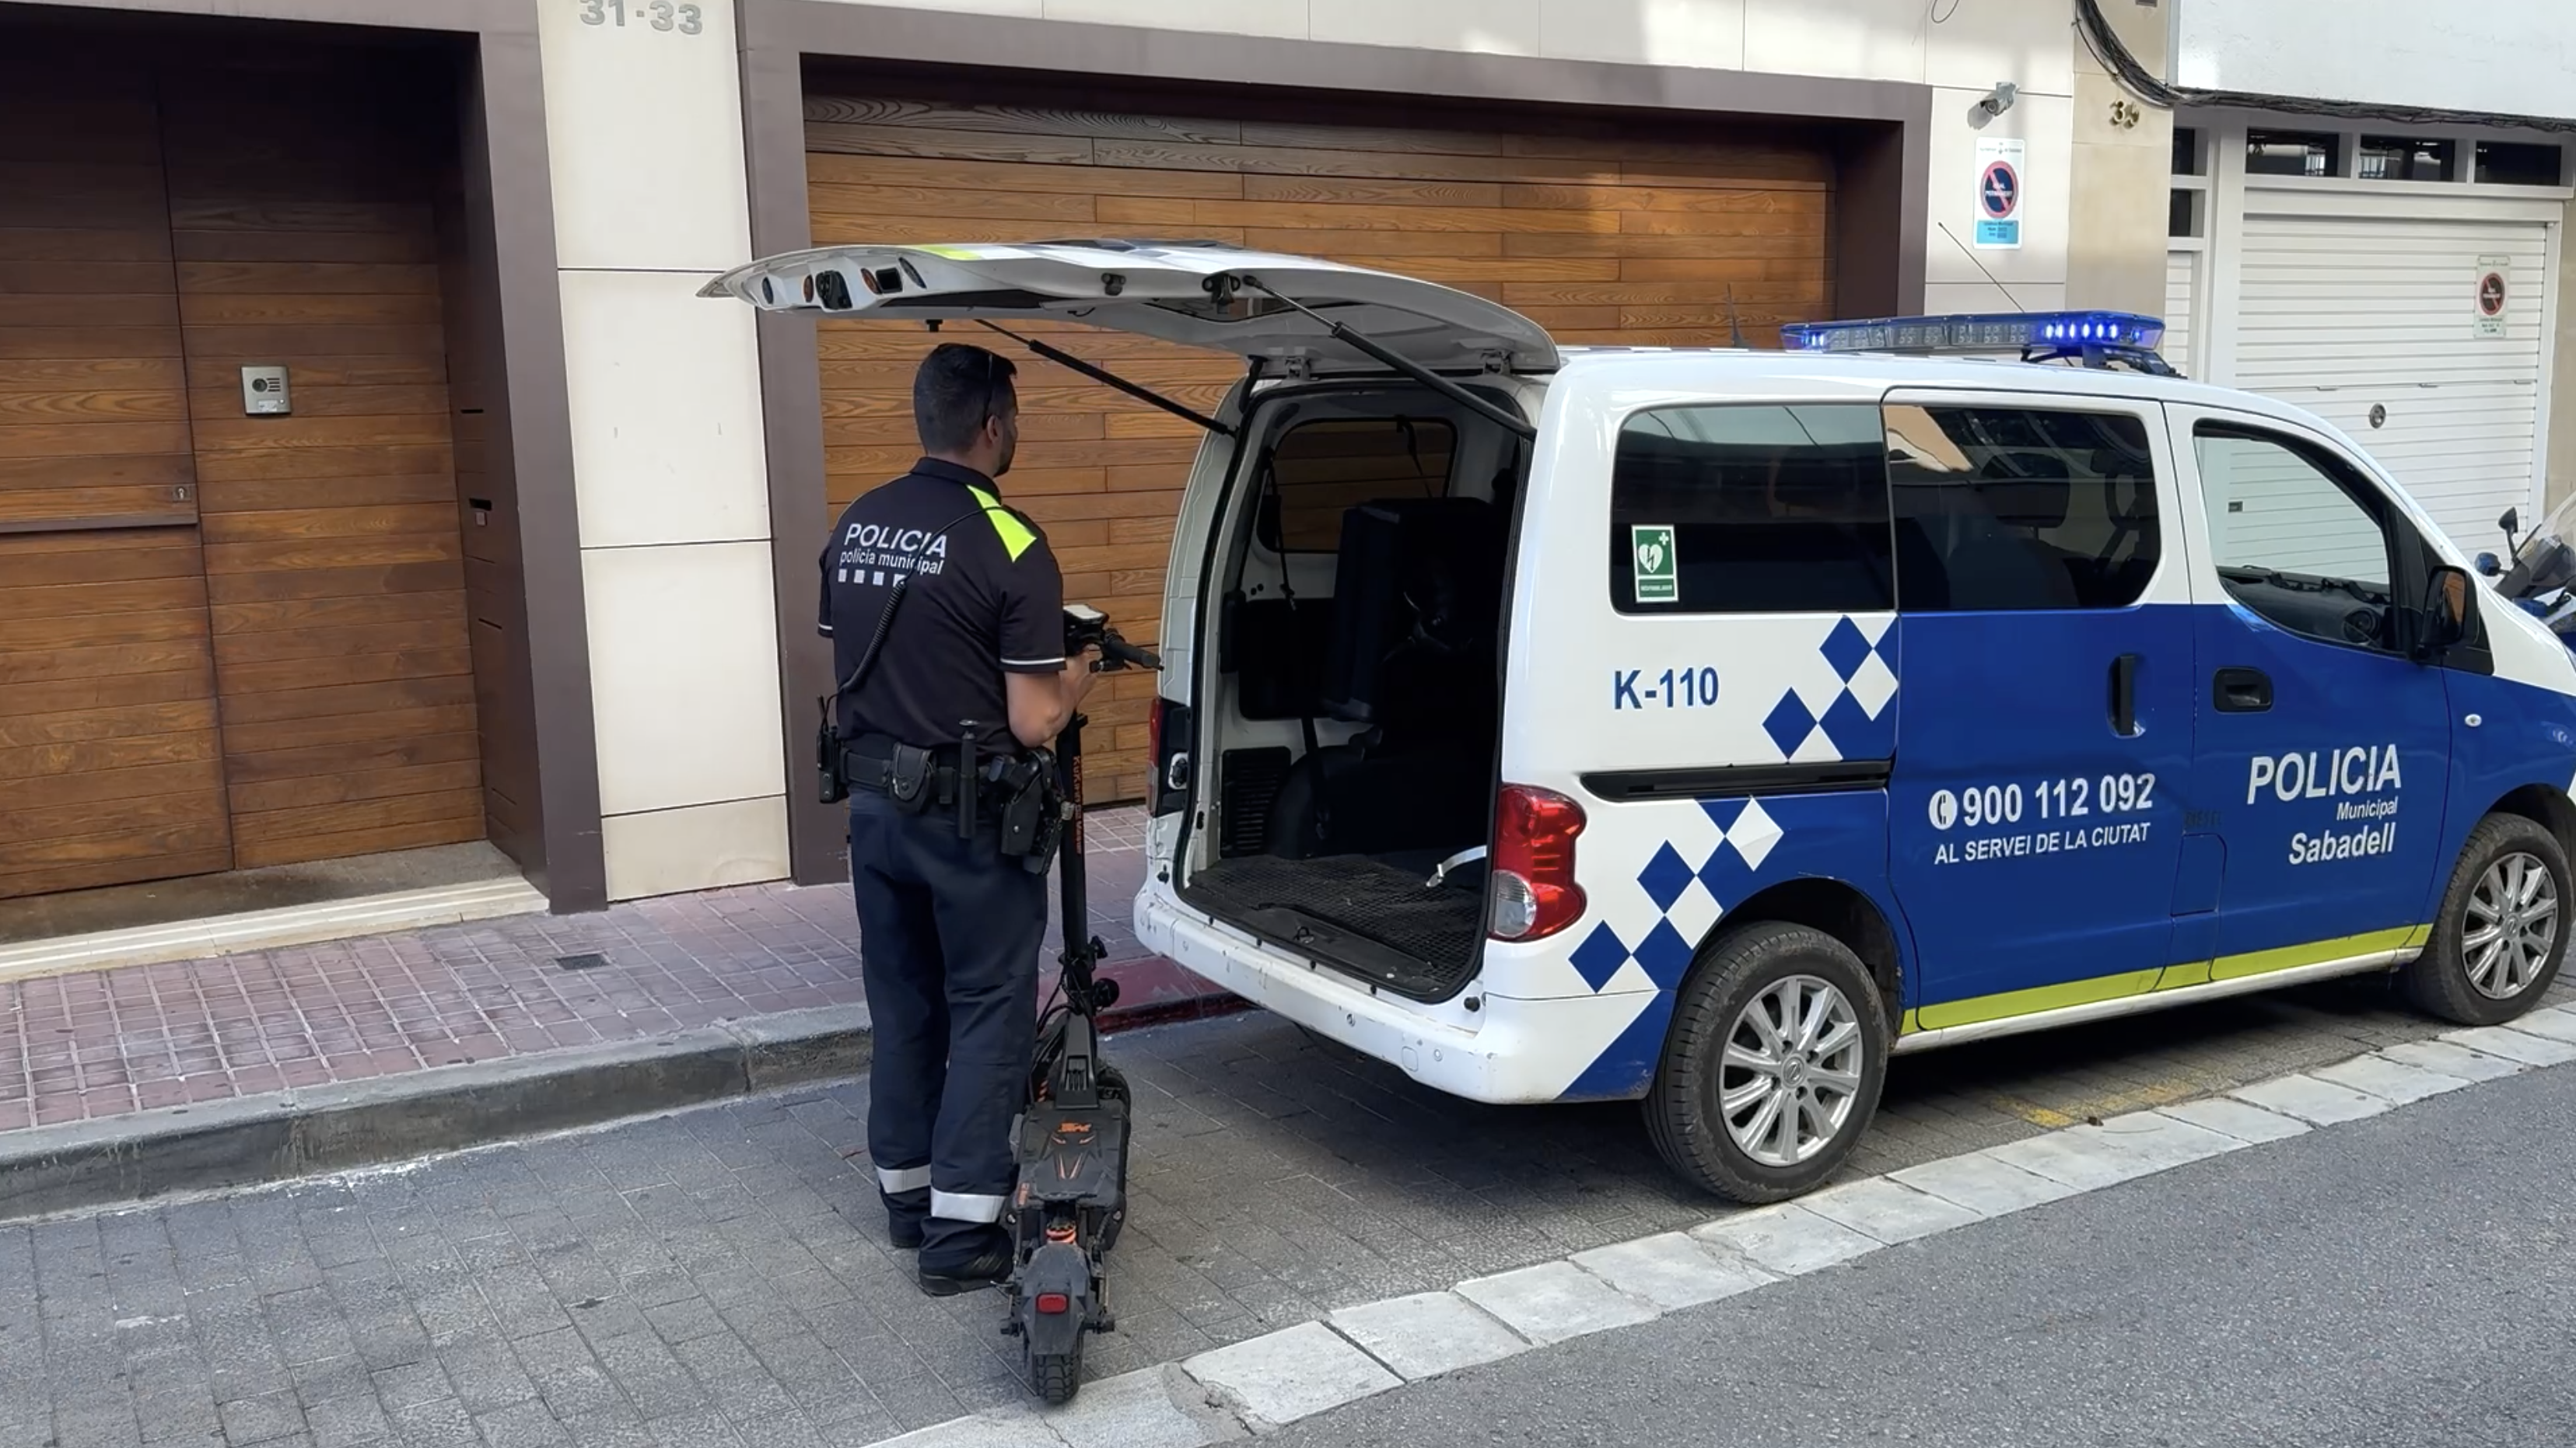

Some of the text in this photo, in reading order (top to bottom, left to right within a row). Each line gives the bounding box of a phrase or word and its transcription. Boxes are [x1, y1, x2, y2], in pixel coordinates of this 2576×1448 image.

[844, 523, 947, 558] POLICIA
[1615, 666, 1719, 709] K-110
[2247, 744, 2401, 805] POLICIA
[1963, 773, 2156, 827] 900 112 092
[2336, 796, 2399, 820] Municipal
[1934, 823, 2151, 865] AL SERVEI DE LA CIUTAT
[2288, 822, 2396, 865] Sabadell
